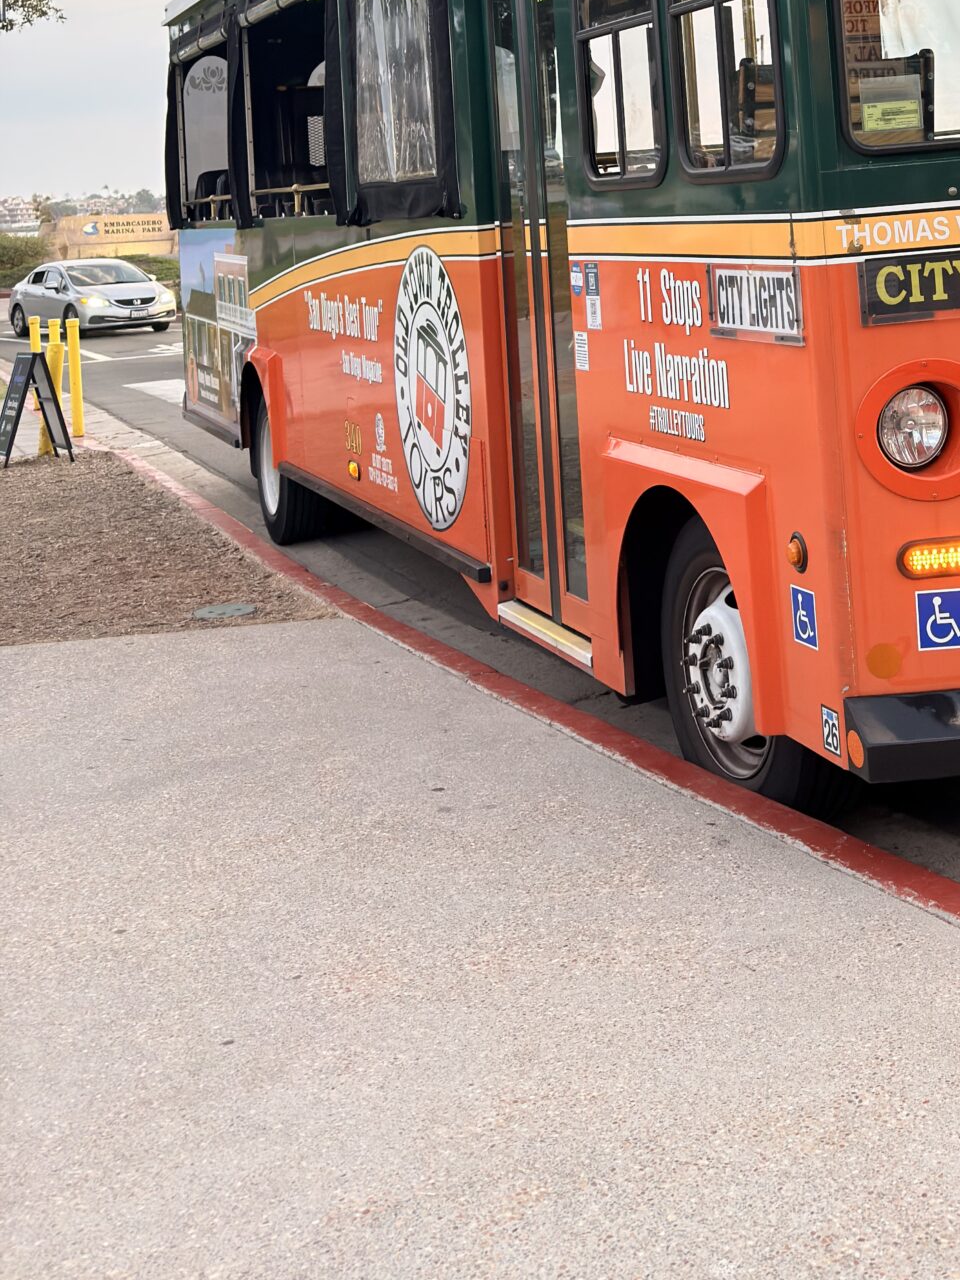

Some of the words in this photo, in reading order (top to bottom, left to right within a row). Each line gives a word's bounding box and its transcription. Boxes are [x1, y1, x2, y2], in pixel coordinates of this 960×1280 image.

[104, 219, 163, 228] EMBARCADERO
[104, 227, 136, 235] MARINA
[836, 215, 950, 248] THOMAS
[402, 251, 433, 316] TOWN
[636, 267, 653, 323] 11
[660, 267, 703, 336] Stops
[717, 273, 744, 326] CITY
[748, 275, 796, 331] LIGHTS
[344, 293, 361, 338] Best
[396, 303, 409, 379] OLD
[437, 264, 470, 459] TROLLEY
[623, 338, 652, 396] Live
[654, 342, 731, 410] Narration
[344, 419, 362, 457] 340
[649, 404, 706, 443] #TROLLEYTOURS
[404, 406, 458, 523] TOURS
[823, 718, 839, 752] 26
